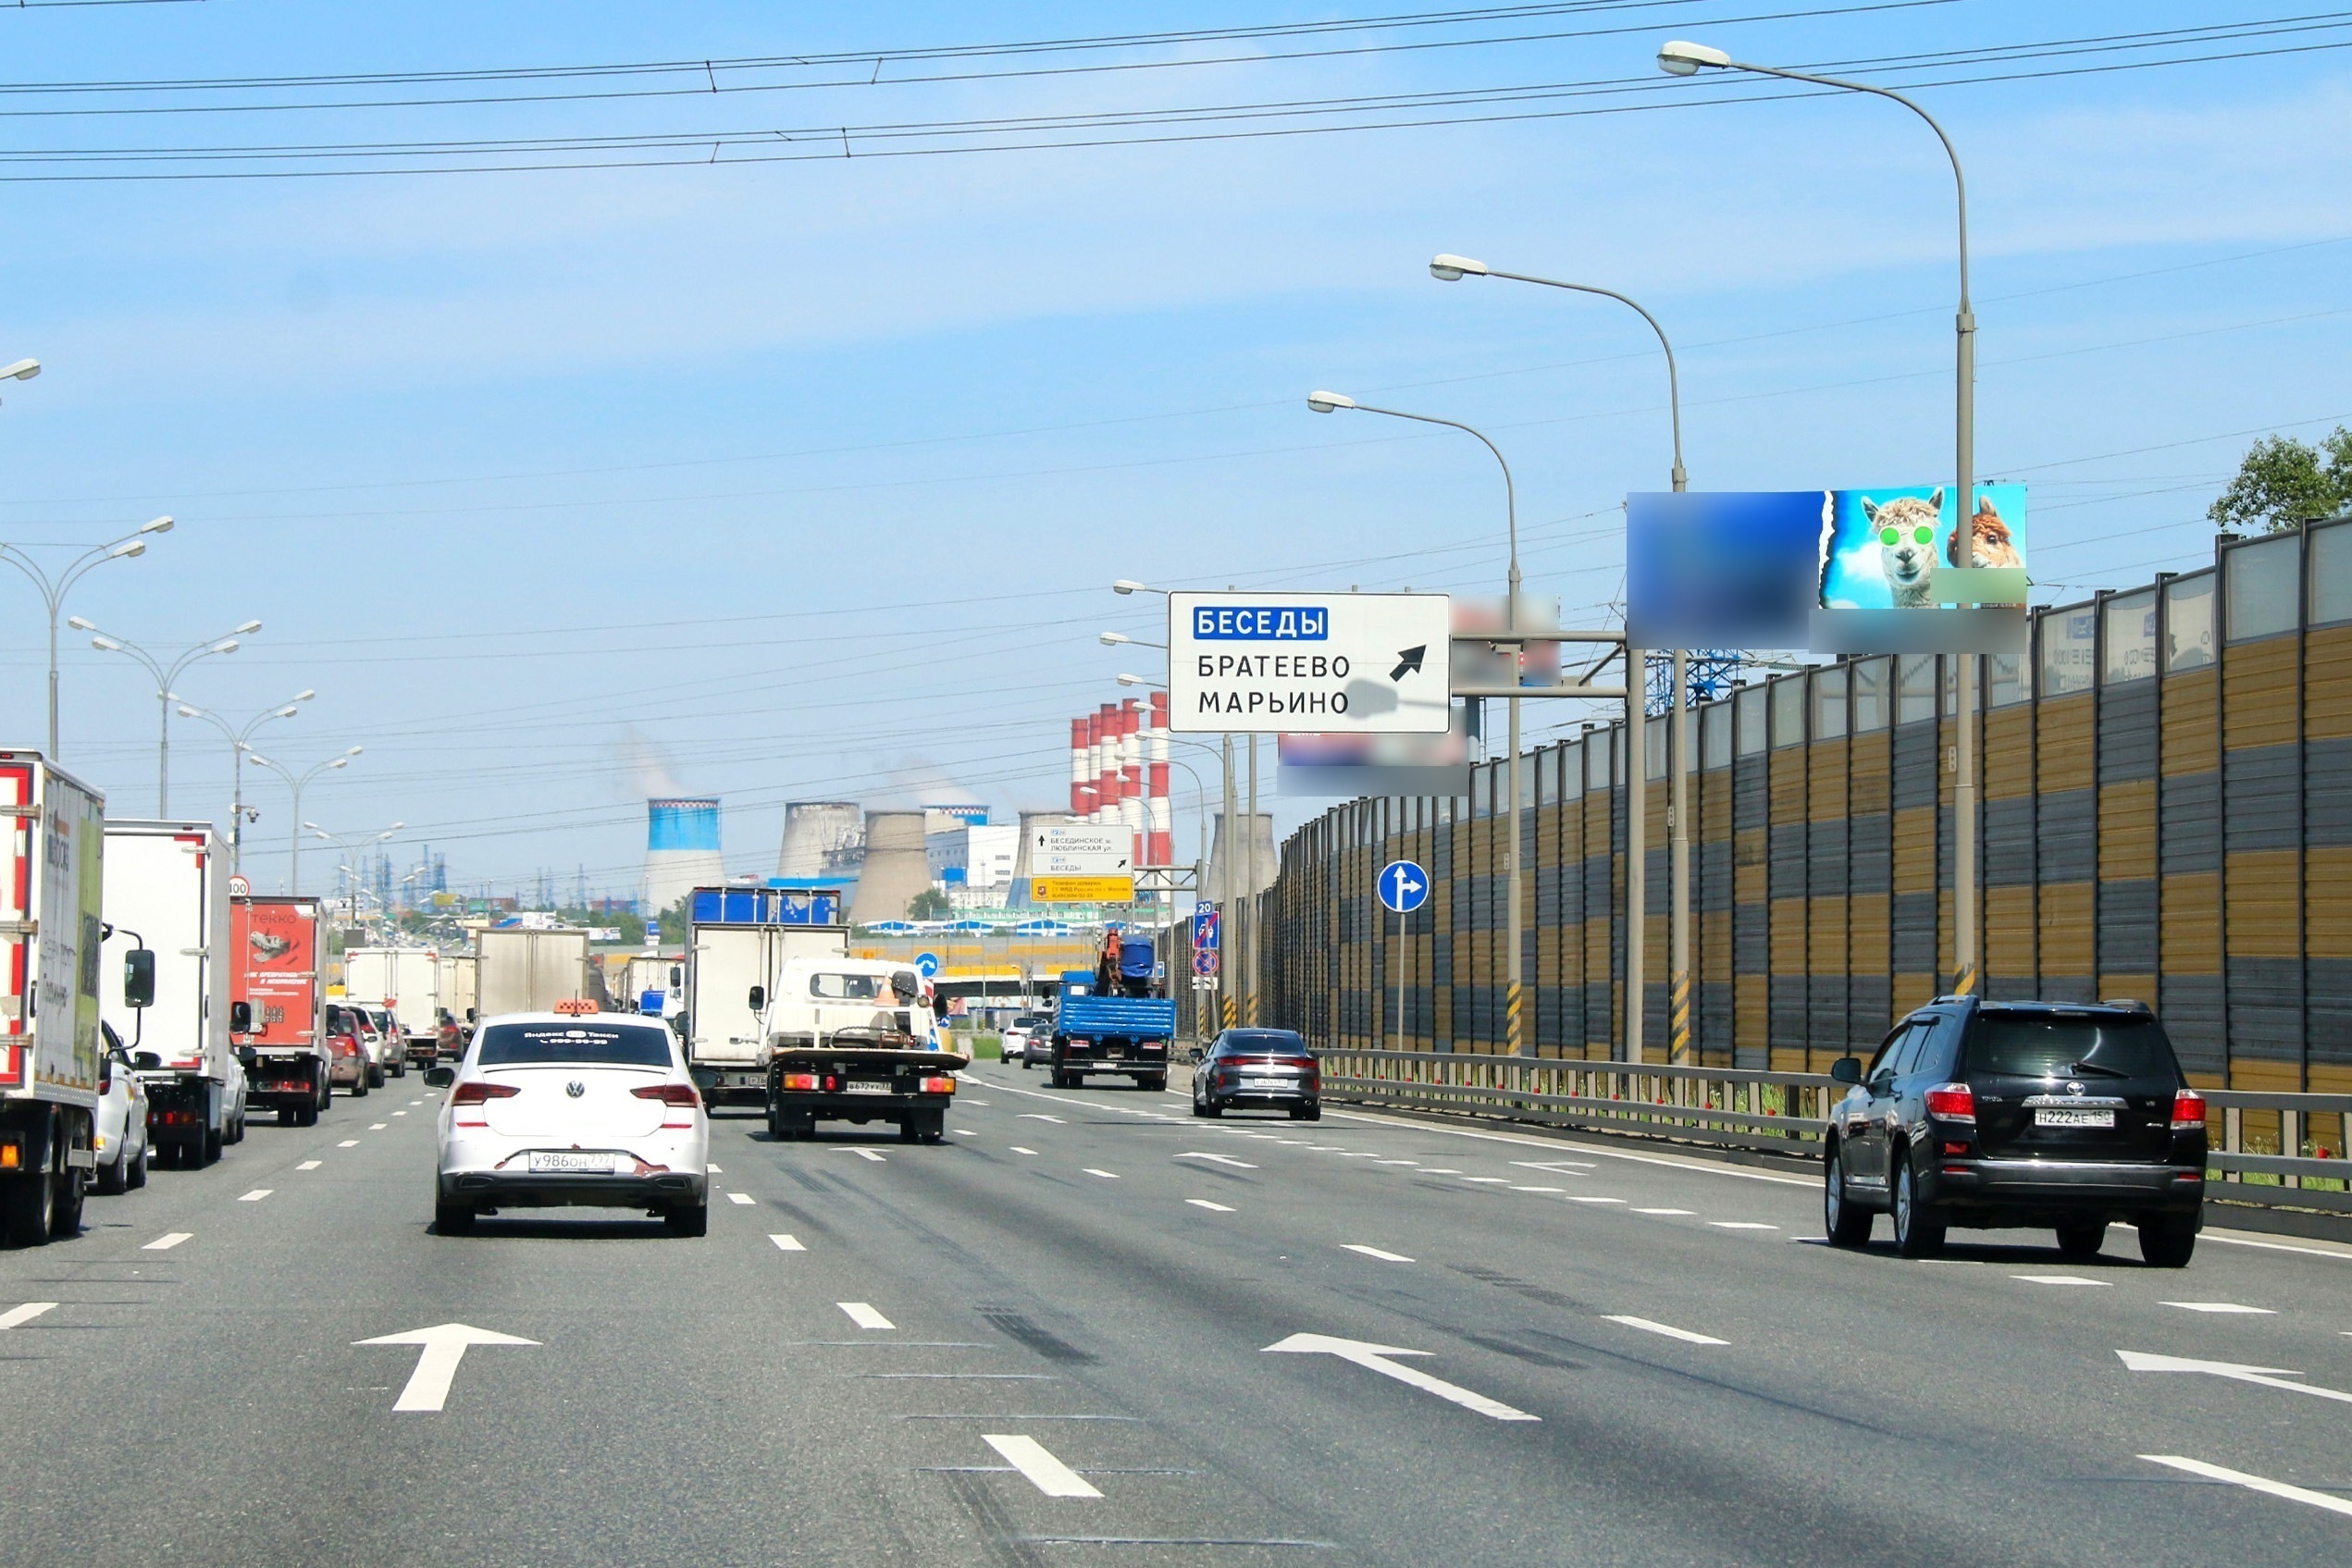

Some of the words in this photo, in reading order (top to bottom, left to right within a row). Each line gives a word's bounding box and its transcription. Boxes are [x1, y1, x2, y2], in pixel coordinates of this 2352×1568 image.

[1198, 611, 1323, 638] БЕСЕДЫ
[1198, 655, 1350, 678] БРАТЕЕВО
[1198, 691, 1349, 714] МАРЬИНО
[1198, 903, 1211, 913] 20
[2039, 1111, 2089, 1124] Н222АЕ
[2092, 1110, 2111, 1121] 150
[534, 1154, 588, 1167] У986ОН
[589, 1153, 611, 1165] 797
